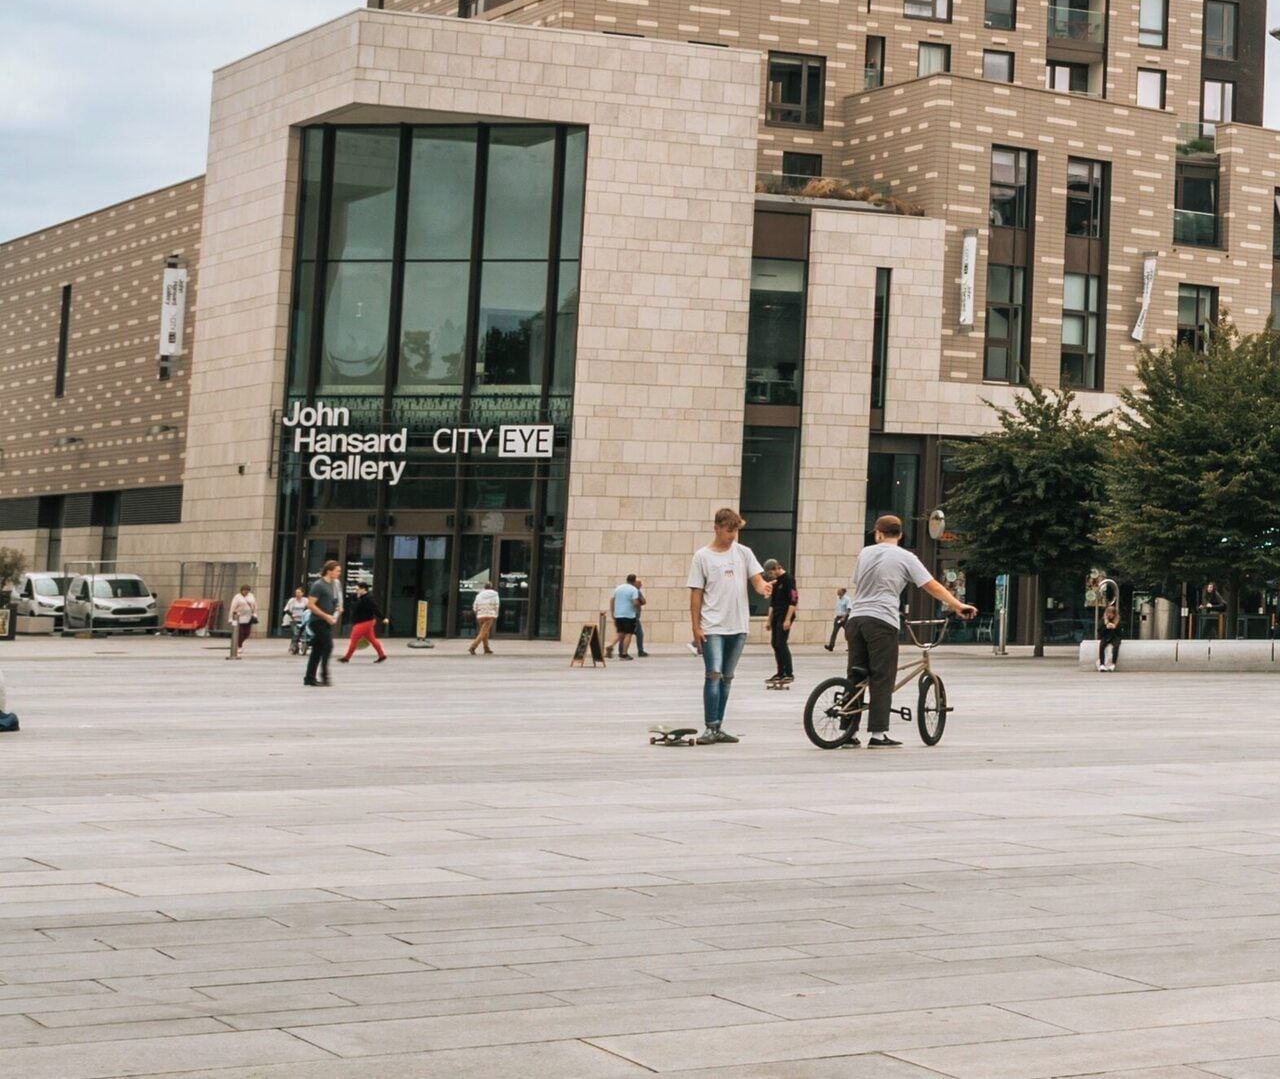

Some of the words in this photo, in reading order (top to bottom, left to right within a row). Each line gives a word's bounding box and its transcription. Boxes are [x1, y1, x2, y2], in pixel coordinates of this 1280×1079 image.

[282, 401, 349, 427] John
[293, 428, 408, 453] Hansard
[432, 428, 494, 454] CITY
[502, 428, 550, 453] EYE
[309, 455, 407, 486] Gallery
